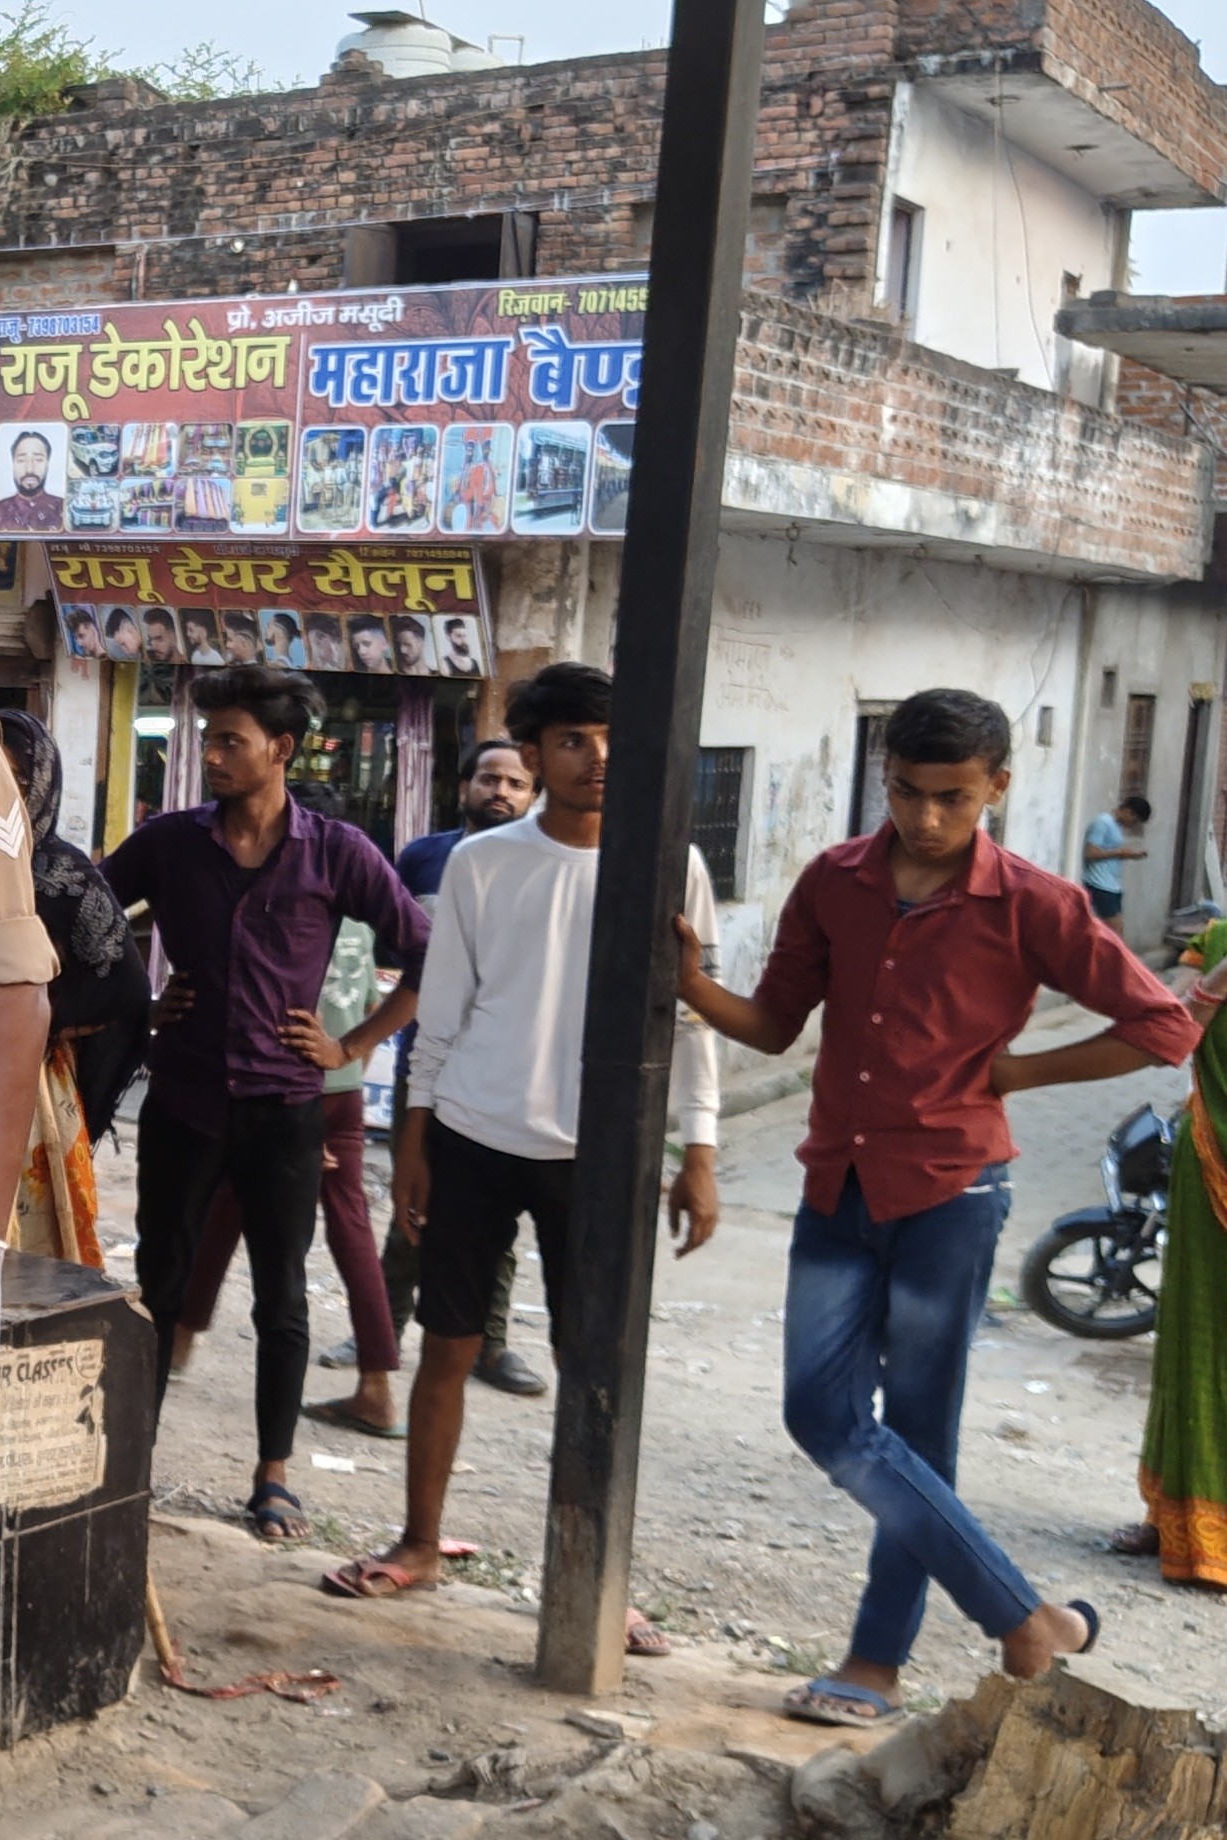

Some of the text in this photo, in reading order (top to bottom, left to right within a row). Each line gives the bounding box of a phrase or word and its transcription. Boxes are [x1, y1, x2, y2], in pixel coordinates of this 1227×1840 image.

[0, 317, 292, 421] राजू डेकोरेशन
[308, 337, 515, 409] महाराजा
[51, 546, 476, 612] राजू हेयर सैलून
